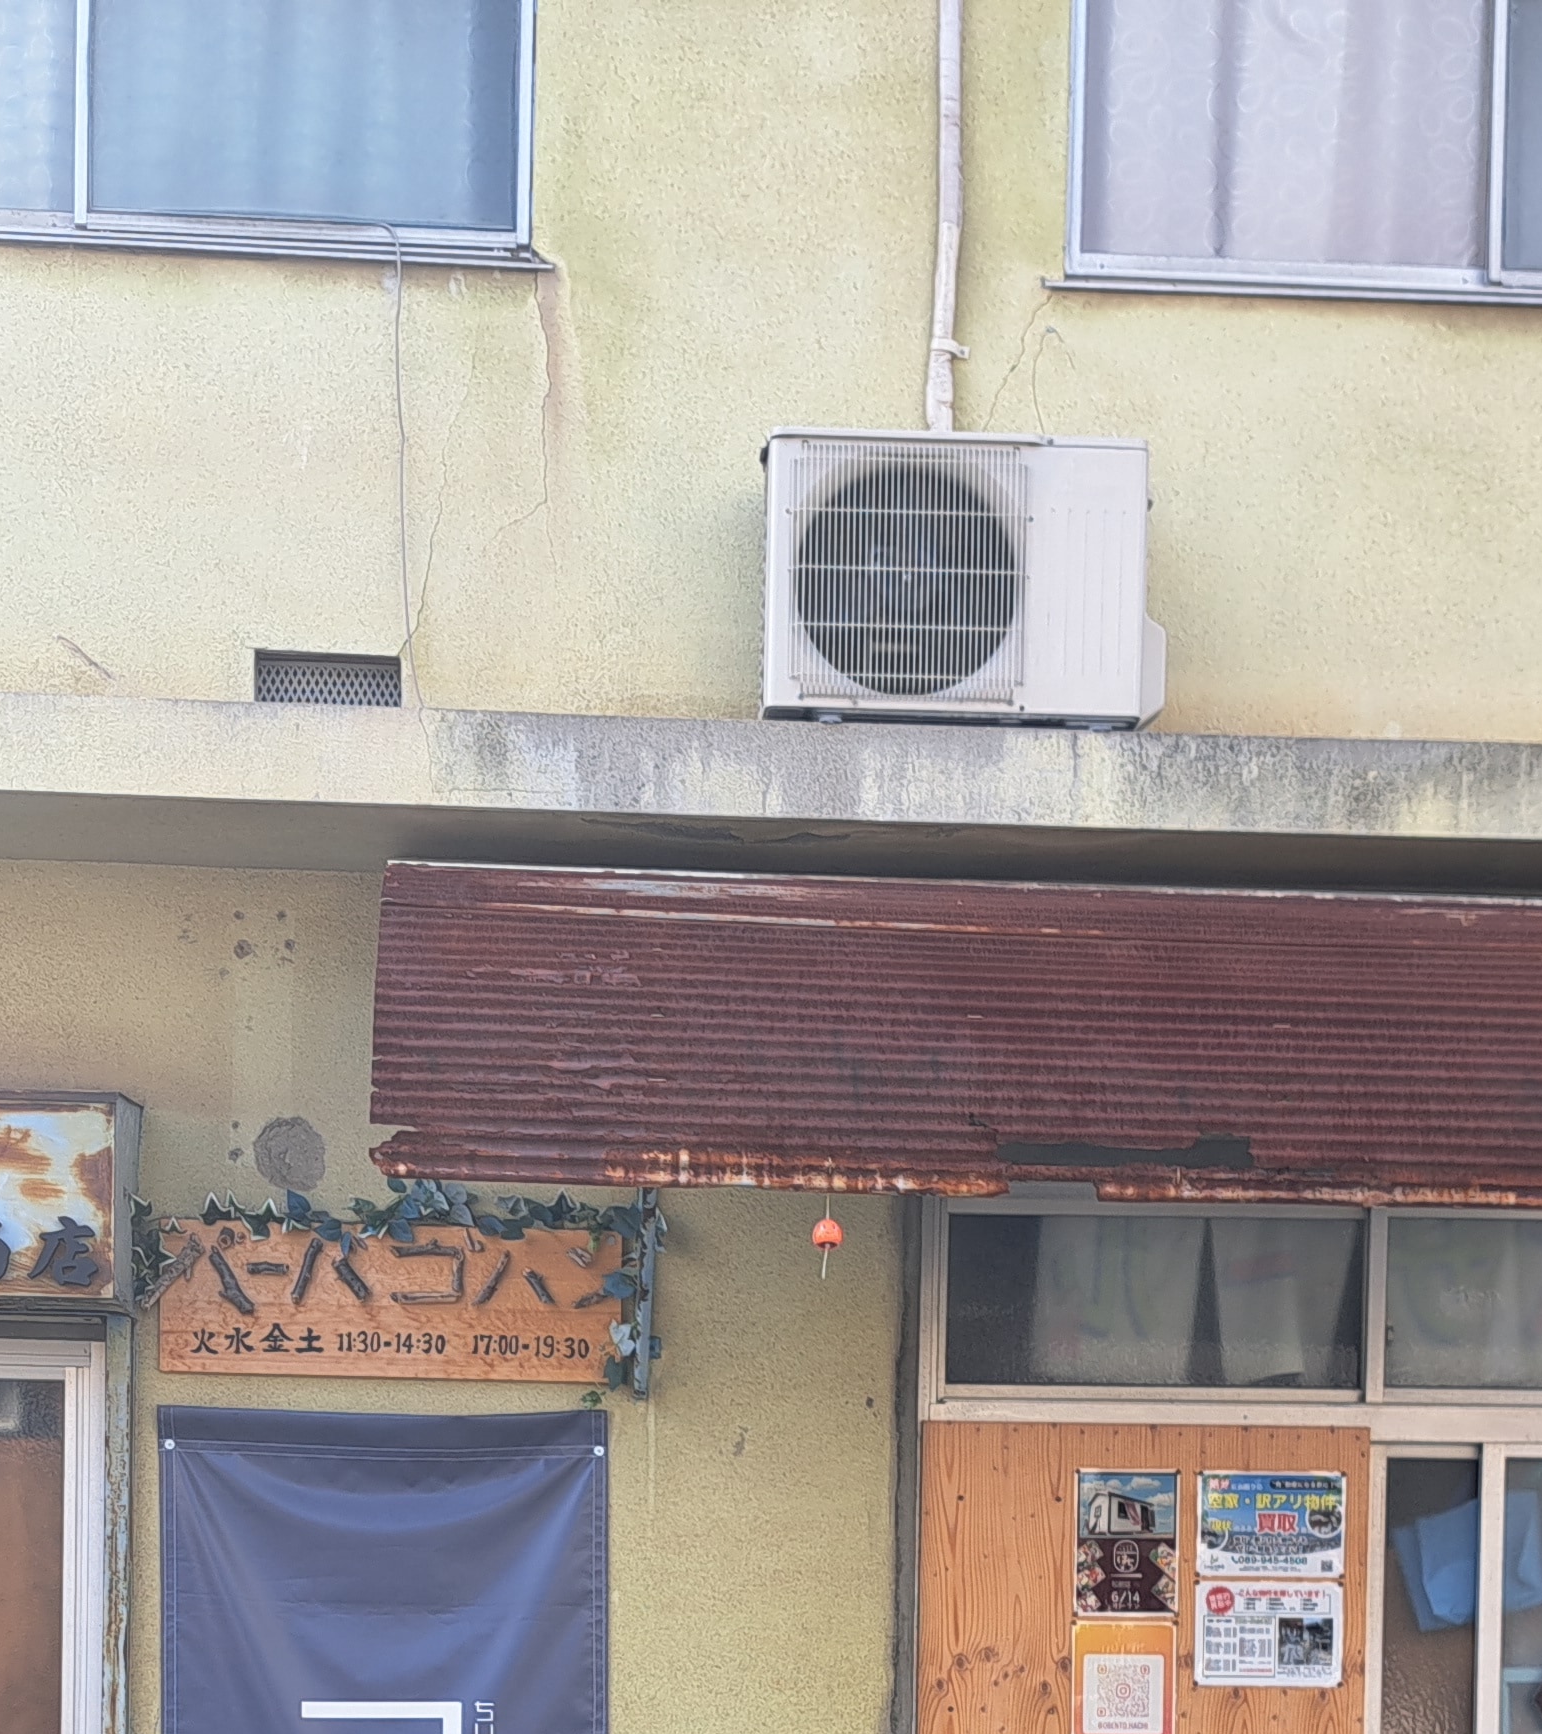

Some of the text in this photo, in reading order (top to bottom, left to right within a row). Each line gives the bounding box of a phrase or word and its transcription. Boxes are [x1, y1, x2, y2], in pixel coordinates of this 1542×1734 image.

[190, 1322, 591, 1360] 火水金土 11:30-14:30 17:00-19:30
